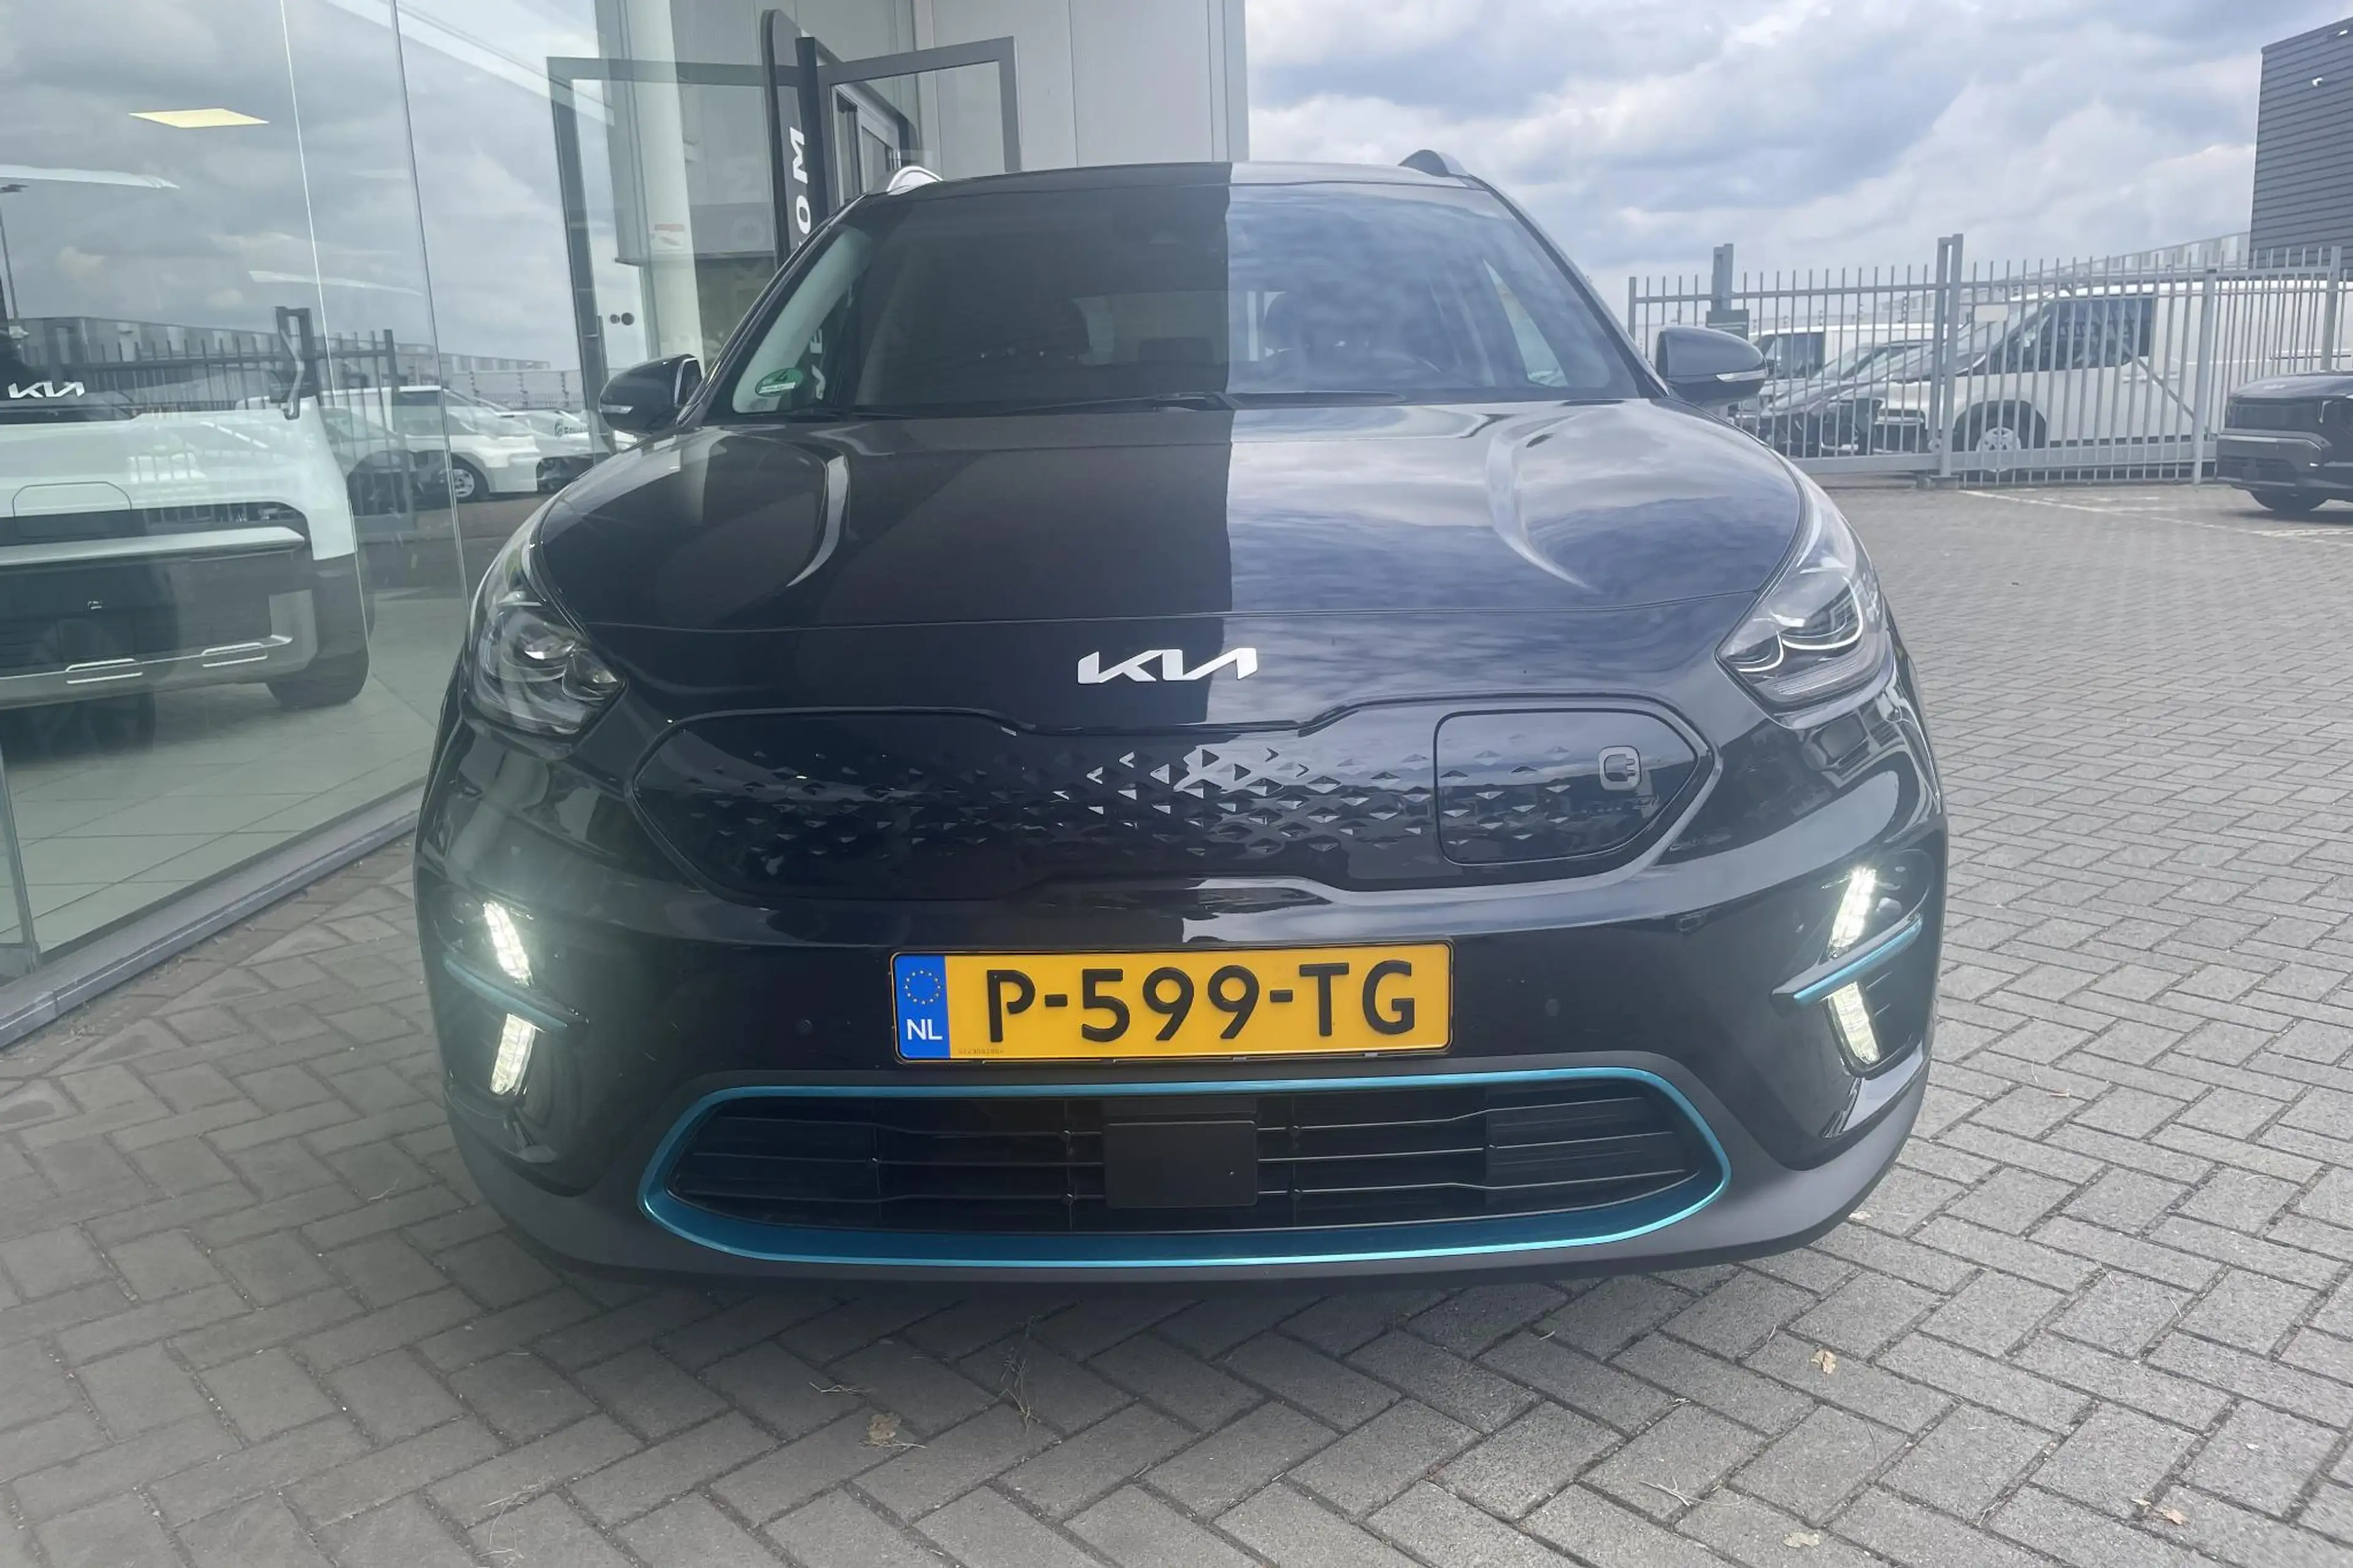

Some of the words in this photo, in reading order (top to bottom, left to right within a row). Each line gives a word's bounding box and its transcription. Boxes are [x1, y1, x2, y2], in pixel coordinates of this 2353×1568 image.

[8, 380, 85, 398] KIA
[1078, 648, 1258, 684] KIA
[986, 960, 1415, 1043] P-599-TG
[906, 1018, 943, 1042] NL
